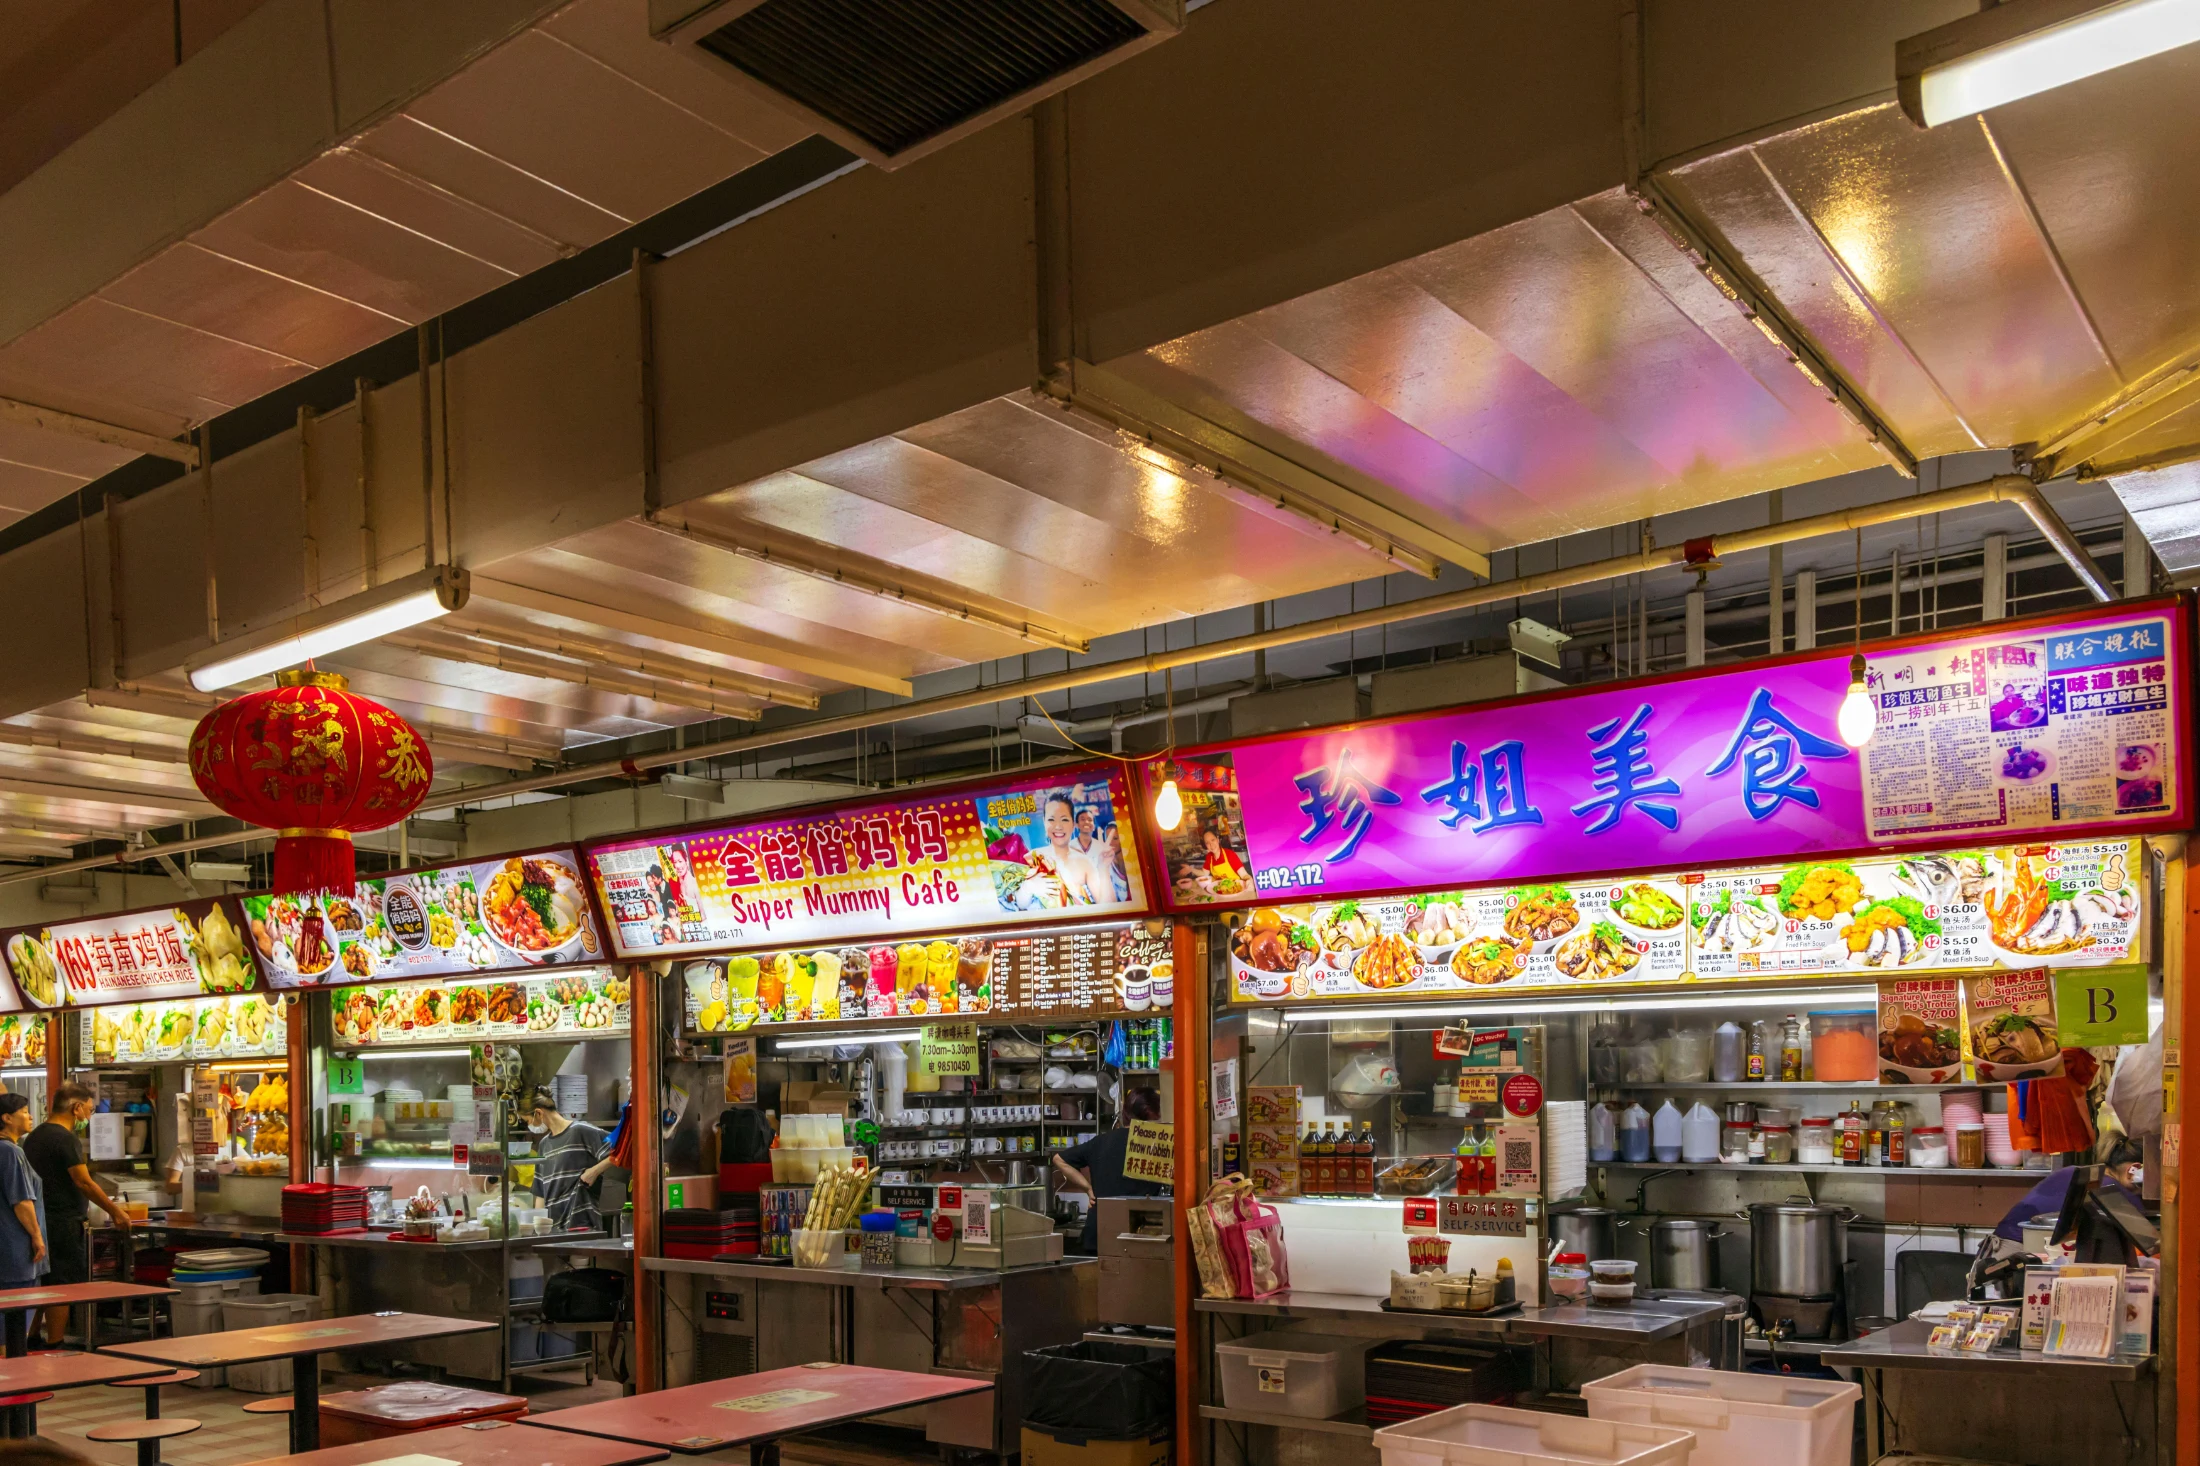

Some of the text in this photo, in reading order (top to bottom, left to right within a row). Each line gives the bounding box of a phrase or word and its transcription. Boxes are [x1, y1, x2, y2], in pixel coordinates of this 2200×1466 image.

[2067, 665, 2165, 693] 味道独特
[1884, 683, 1969, 708] 珍姐发财鱼生
[2072, 686, 2165, 710] 珍姐发财鱼生
[1293, 687, 1852, 864] 珍姐美食
[987, 795, 1036, 818] 全能俏妈妈
[998, 815, 1031, 829] Connie
[718, 810, 949, 887] 全能俏妈妈
[2062, 843, 2127, 855] 海鲜汤 $5.50
[2047, 851, 2059, 860] 14
[2062, 863, 2098, 872] 海鲜伊面
[1256, 863, 1324, 889] #02-172
[2047, 869, 2059, 878] 15
[1700, 881, 1728, 889] $5.50
[1733, 878, 1761, 887] $6.10
[2062, 880, 2096, 889] $6.10
[731, 868, 960, 931] Super Mummy Cafe
[1580, 890, 1607, 900] $4.00
[388, 895, 412, 911] 全能
[1479, 898, 1504, 907] $5.00
[1380, 904, 1404, 914] $5.00
[1927, 904, 1978, 916] 13 $6.00
[389, 909, 421, 924] 俏妈妈
[1943, 916, 1970, 924] 鱼头汤
[1801, 921, 1833, 931] $5.50
[2092, 922, 2128, 930] 打包另加
[713, 928, 744, 940] #02-171
[1652, 940, 1681, 949] $4.00
[1926, 936, 1978, 947] 12 $5.50
[2097, 937, 2126, 945] $0.30
[1120, 940, 1166, 957] Coffee
[1943, 948, 1971, 956] 双鱼汤
[54, 923, 189, 992] 169 海南鸡饭
[1529, 955, 1556, 964] $5.00
[1326, 970, 1350, 979] $5.00
[1424, 965, 1449, 974] $6.00
[98, 967, 196, 989] HAINANESE CHICKEN RICE
[1257, 979, 1279, 987] $7.00
[1993, 969, 2044, 987] 招牌鸡酒
[1994, 982, 2046, 996] Signature
[1881, 992, 1956, 1003] Signature Vinegar
[1975, 992, 2048, 1009] Wine Chicken
[1904, 1000, 1956, 1011] Pig's Trotter
[2085, 987, 2118, 1024] B
[1921, 1009, 1956, 1020] $7.00
[1474, 1032, 1506, 1043] CDC Voucher
[728, 1039, 748, 1050] Today
[726, 1045, 749, 1058] Special
[1473, 1046, 1499, 1055] Accepted
[928, 1059, 971, 1073] 电 98510450
[339, 1068, 354, 1085] B
[1133, 1124, 1169, 1141] Please do
[1129, 1140, 1145, 1155] throw
[1146, 1142, 1170, 1159] rubbish
[887, 1197, 926, 1206] SELF SERVICE
[1443, 1219, 1523, 1233] SELF-SERVICE
